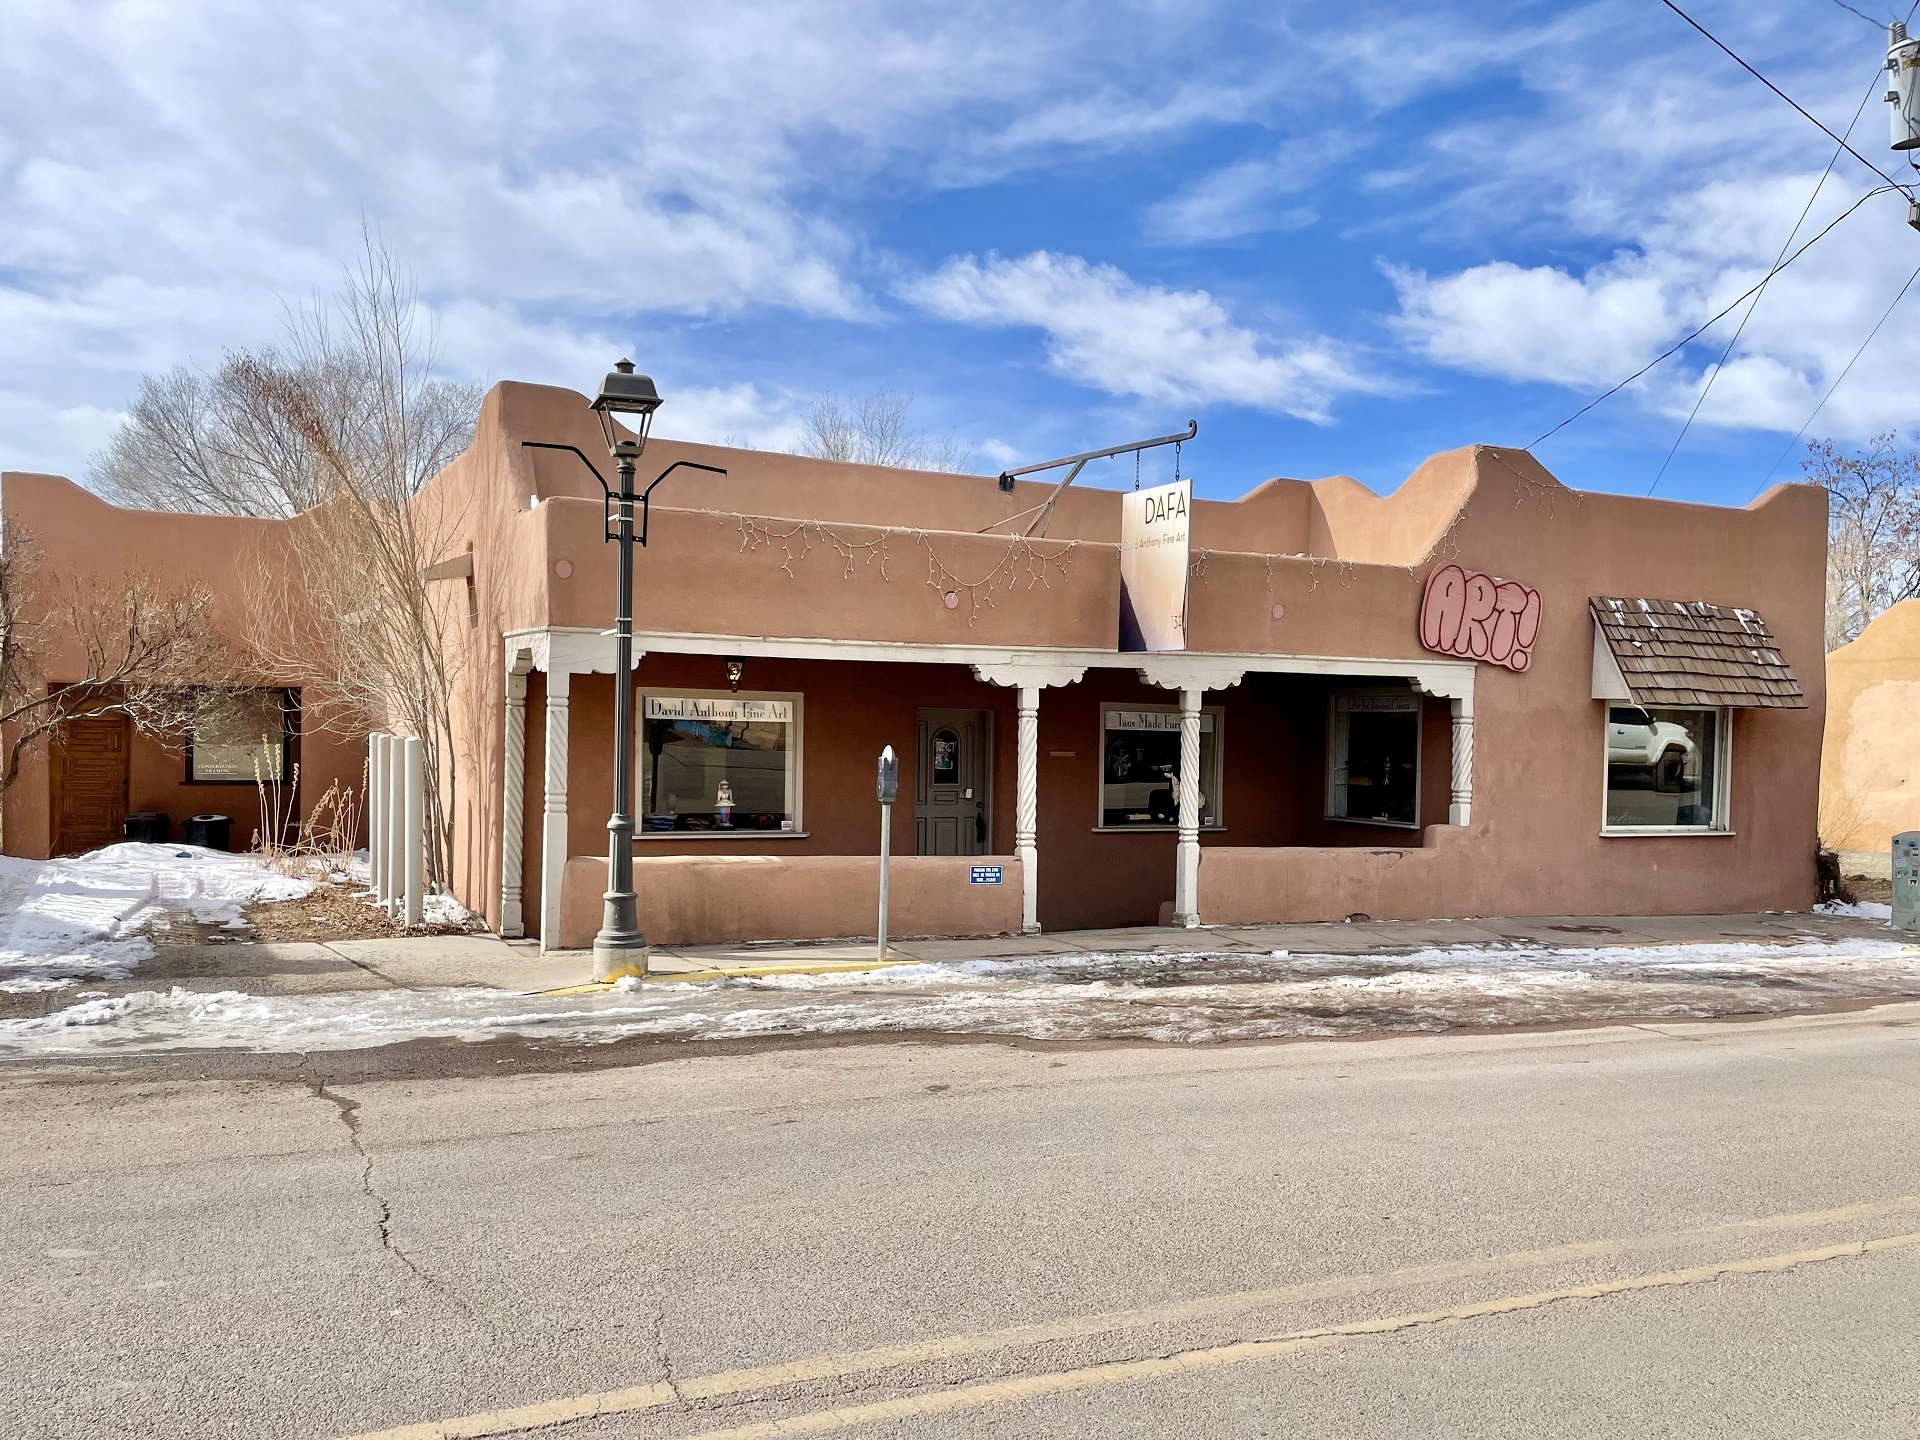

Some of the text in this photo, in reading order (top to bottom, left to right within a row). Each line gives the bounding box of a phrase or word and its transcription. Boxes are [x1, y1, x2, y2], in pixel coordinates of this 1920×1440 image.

[1145, 490, 1187, 525] DAFA
[1124, 532, 1186, 551] David Anthony Fine Art
[1424, 565, 1541, 670] ART!
[650, 698, 787, 720] David Anthony Fine Art
[1115, 712, 1136, 728] Taos
[1138, 713, 1162, 729] Made
